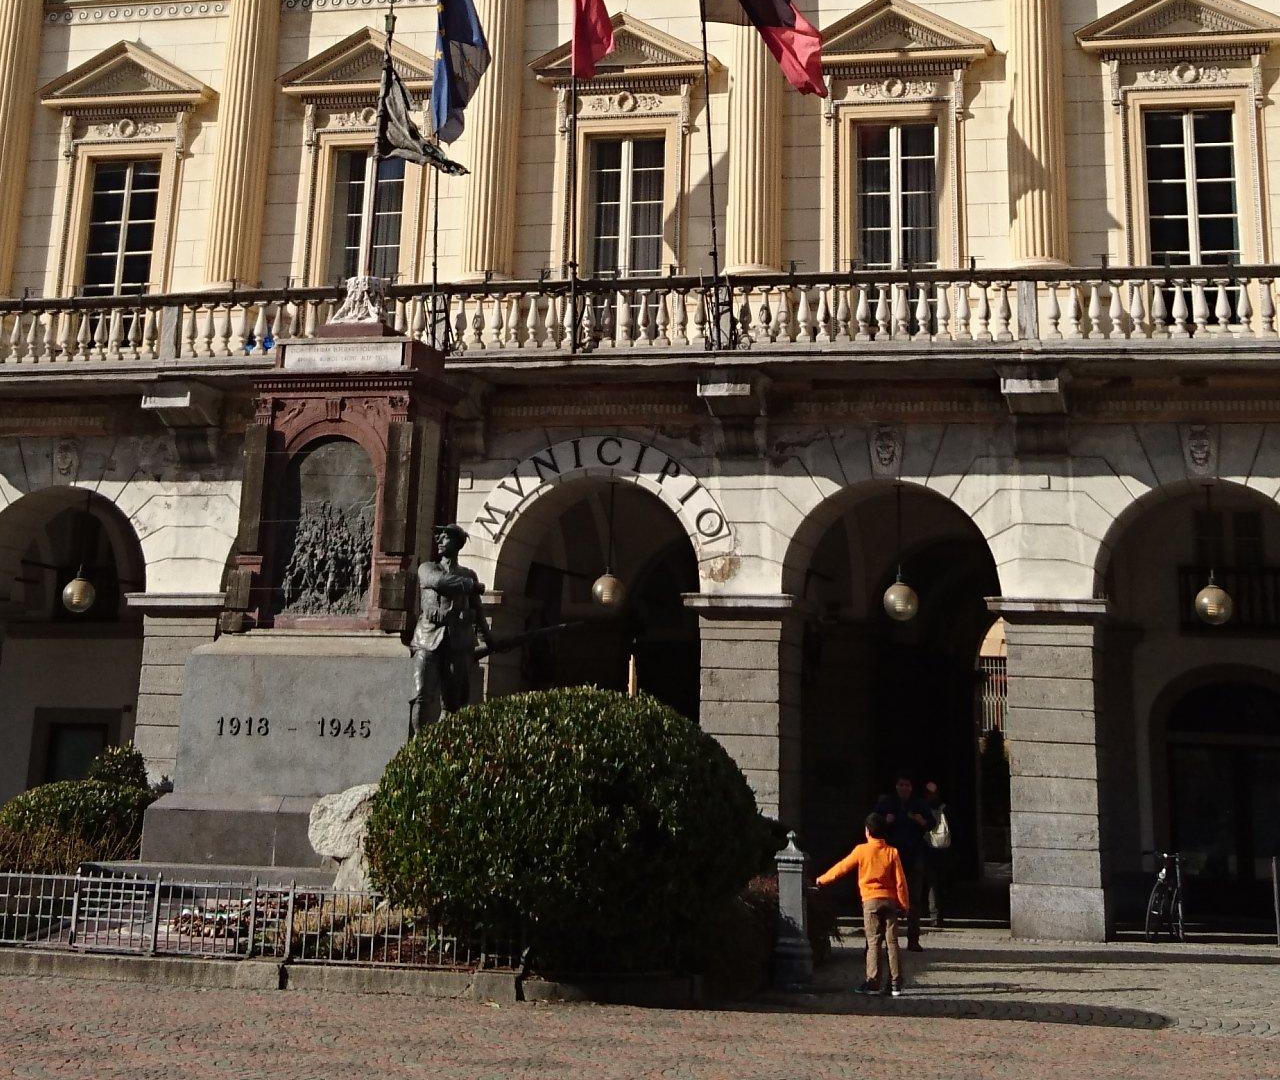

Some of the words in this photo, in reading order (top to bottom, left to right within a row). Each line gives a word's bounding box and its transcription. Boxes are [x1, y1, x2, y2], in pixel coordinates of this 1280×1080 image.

[475, 437, 724, 544] MVNICIPIO
[216, 716, 270, 737] 1918
[317, 716, 372, 738] 1945
